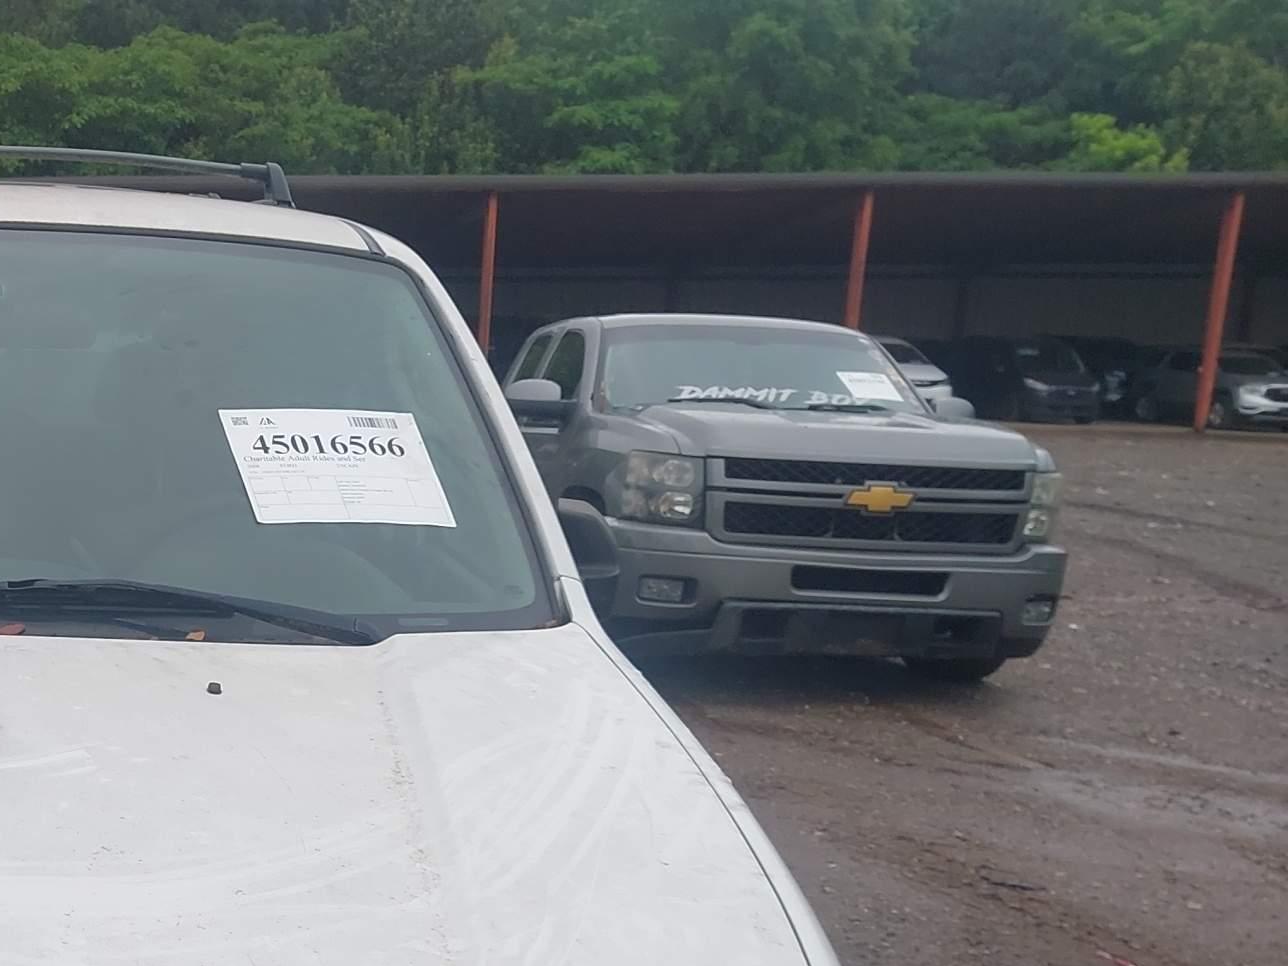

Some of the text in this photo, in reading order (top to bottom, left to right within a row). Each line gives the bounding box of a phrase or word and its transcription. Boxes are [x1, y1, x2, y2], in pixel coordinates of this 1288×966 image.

[674, 385, 798, 402] DAMMIT
[252, 433, 405, 458] 45016566
[312, 455, 335, 463] Rides
